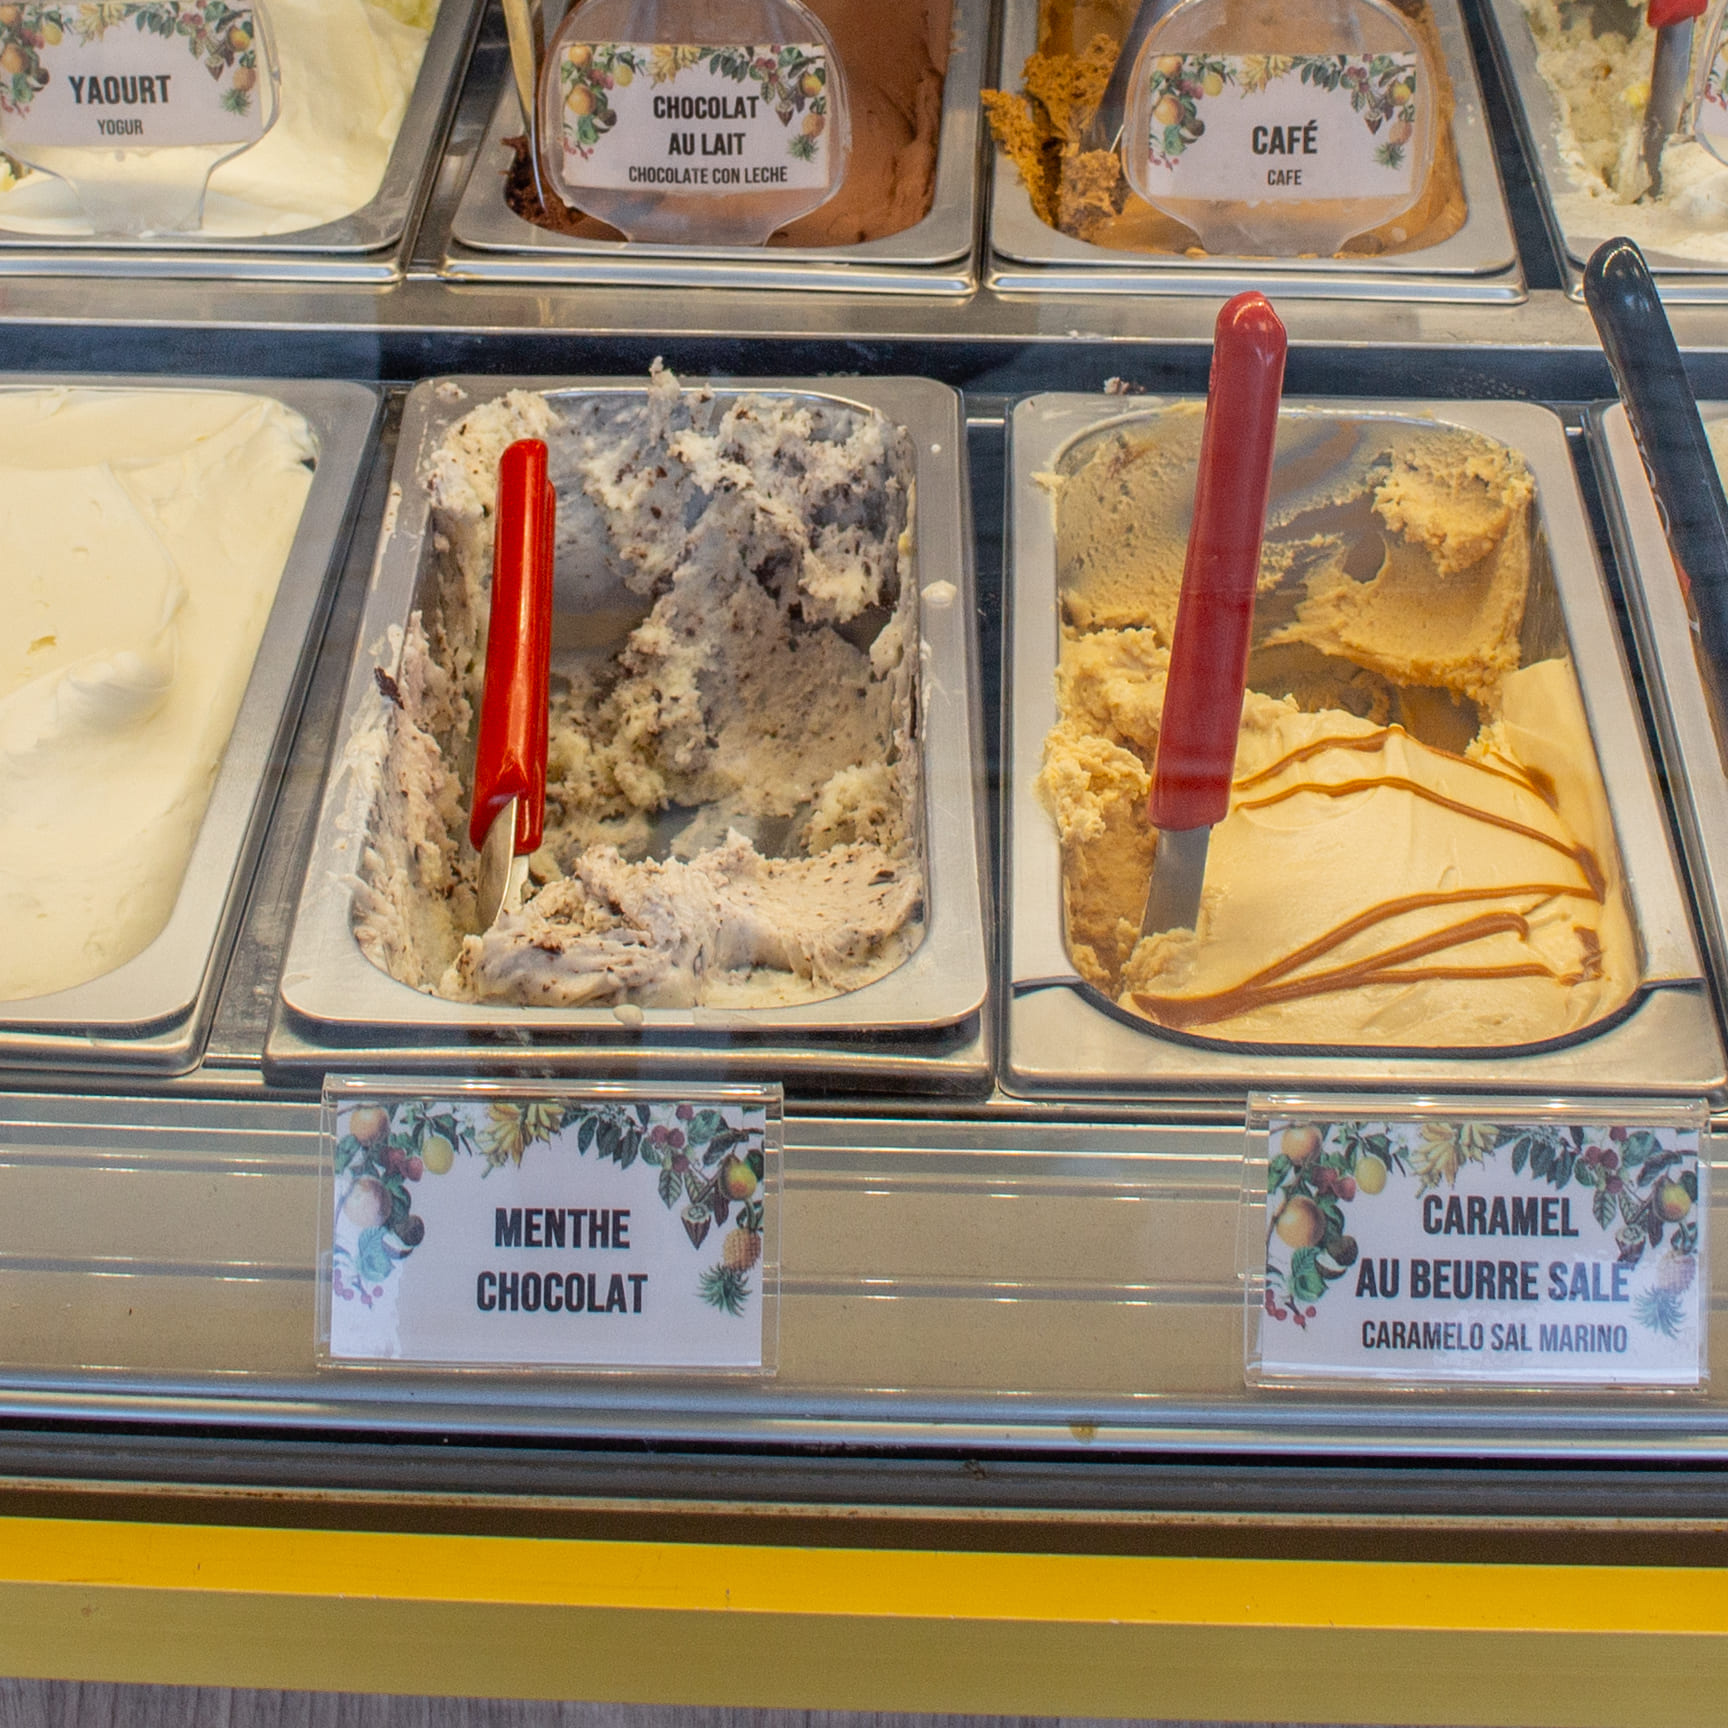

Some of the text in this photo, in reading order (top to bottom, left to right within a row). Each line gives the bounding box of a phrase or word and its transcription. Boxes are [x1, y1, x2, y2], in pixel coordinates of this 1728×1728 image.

[68, 74, 171, 105] YAOURT
[652, 94, 760, 120] CHOCOLAT
[96, 118, 144, 136] YOGUR
[1251, 120, 1318, 155] CAFÉ
[668, 131, 746, 156] AU LAIT
[627, 165, 788, 185] CHOCOLATE CON LECHE
[1267, 168, 1302, 186] CAFE
[494, 1207, 631, 1249] MENTHE
[1423, 1195, 1579, 1238] CARAMEL
[476, 1271, 649, 1314] CHOCOLAT
[1355, 1259, 1400, 1299] AU
[1410, 1259, 1540, 1301] BEURRE
[1361, 1320, 1628, 1354] CARAMELO SAL MARINO
